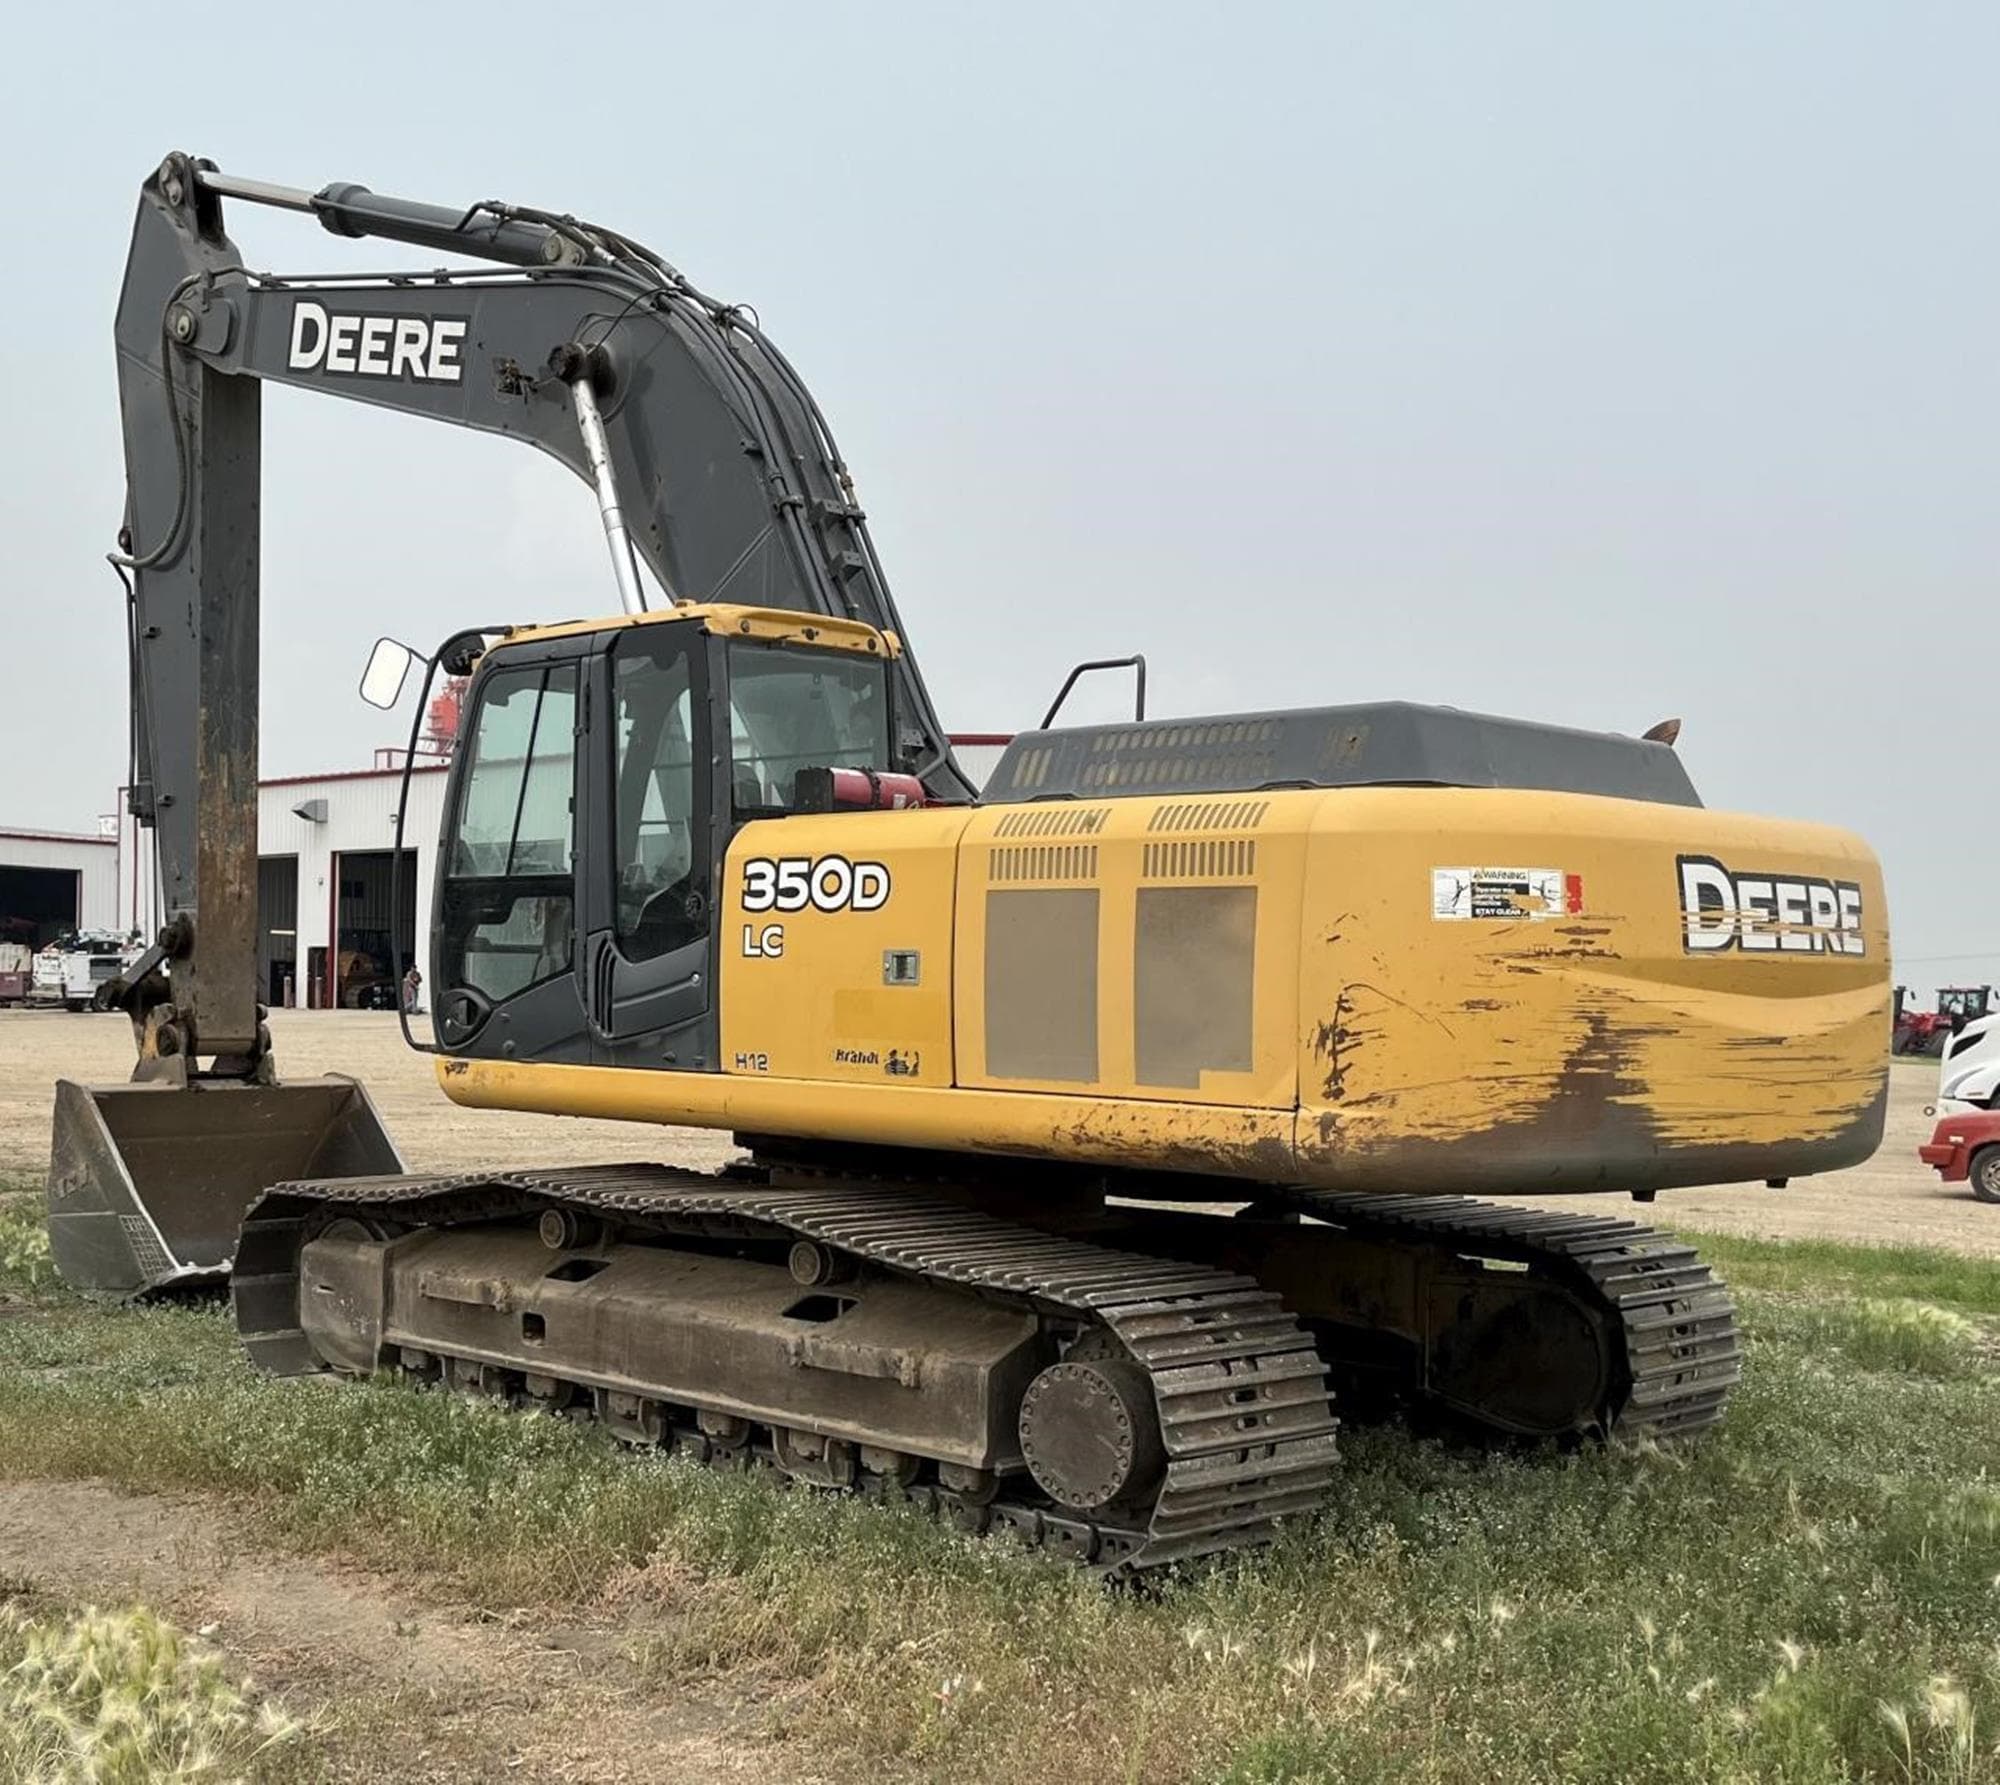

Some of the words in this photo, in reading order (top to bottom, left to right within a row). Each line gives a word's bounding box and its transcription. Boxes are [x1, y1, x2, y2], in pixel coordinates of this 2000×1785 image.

[289, 302, 466, 380] DEERE
[742, 855, 891, 912] 350D
[1682, 862, 1865, 954] DEERE
[743, 924, 784, 957] LC
[736, 1053, 768, 1070] H12
